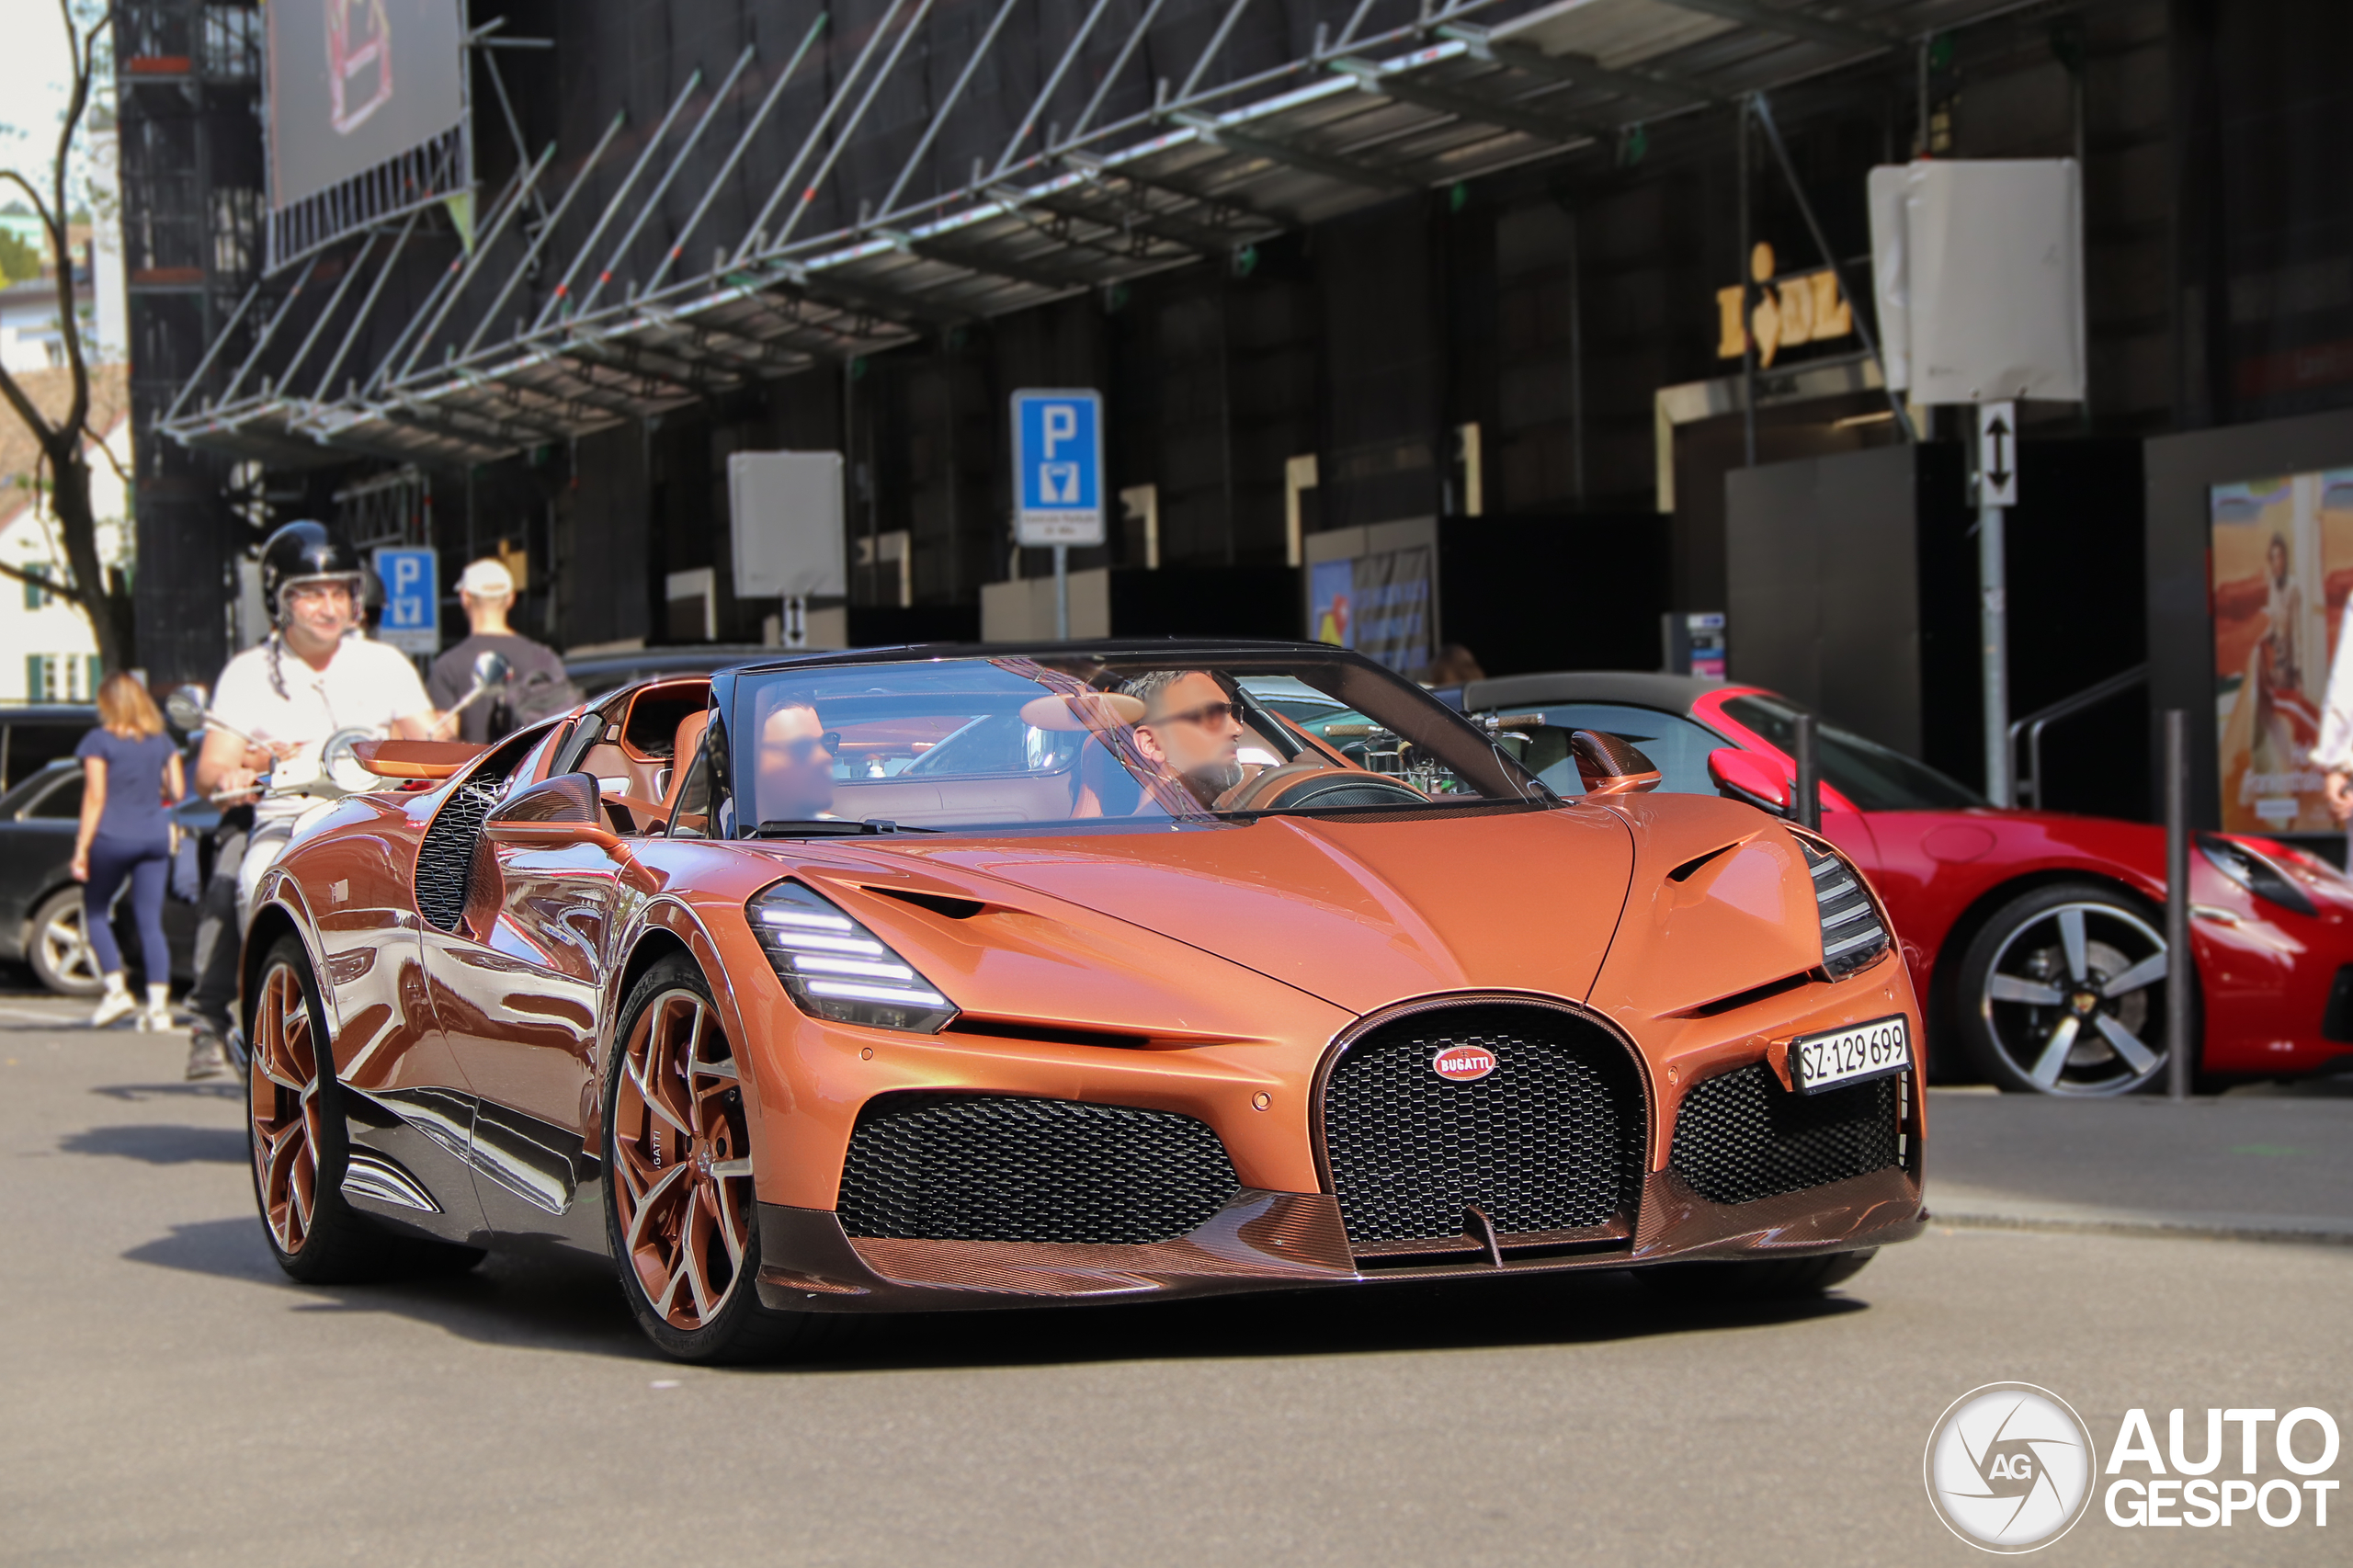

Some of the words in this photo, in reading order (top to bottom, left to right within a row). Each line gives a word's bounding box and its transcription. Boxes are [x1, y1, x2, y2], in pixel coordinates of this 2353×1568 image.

[1042, 405, 1077, 460] P
[395, 557, 420, 596] P
[1439, 1055, 1490, 1074] BUGATTI
[653, 1130, 662, 1170] GATTI
